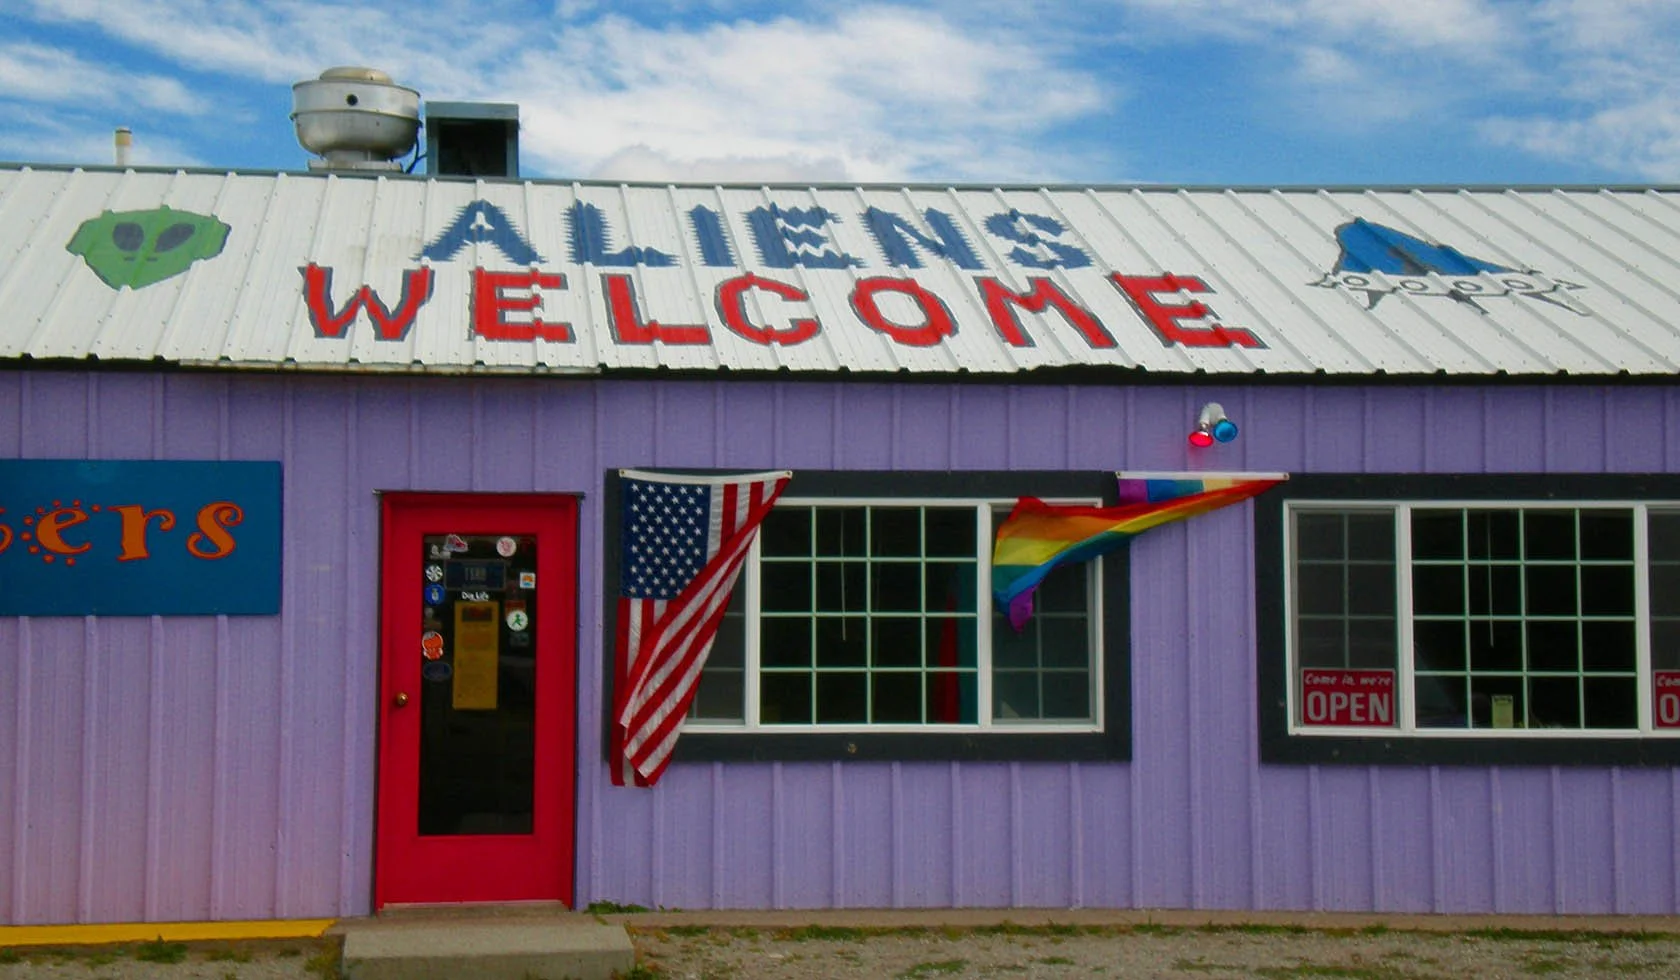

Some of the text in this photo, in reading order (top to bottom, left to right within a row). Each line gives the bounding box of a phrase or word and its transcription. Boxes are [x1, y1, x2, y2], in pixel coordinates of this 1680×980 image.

[411, 199, 1093, 269] ALIENS
[298, 262, 1269, 349] WELCOME
[1305, 673, 1337, 685] Come
[1360, 675, 1391, 686] we're
[1307, 691, 1389, 722] OPEN
[1660, 693, 1679, 723] O
